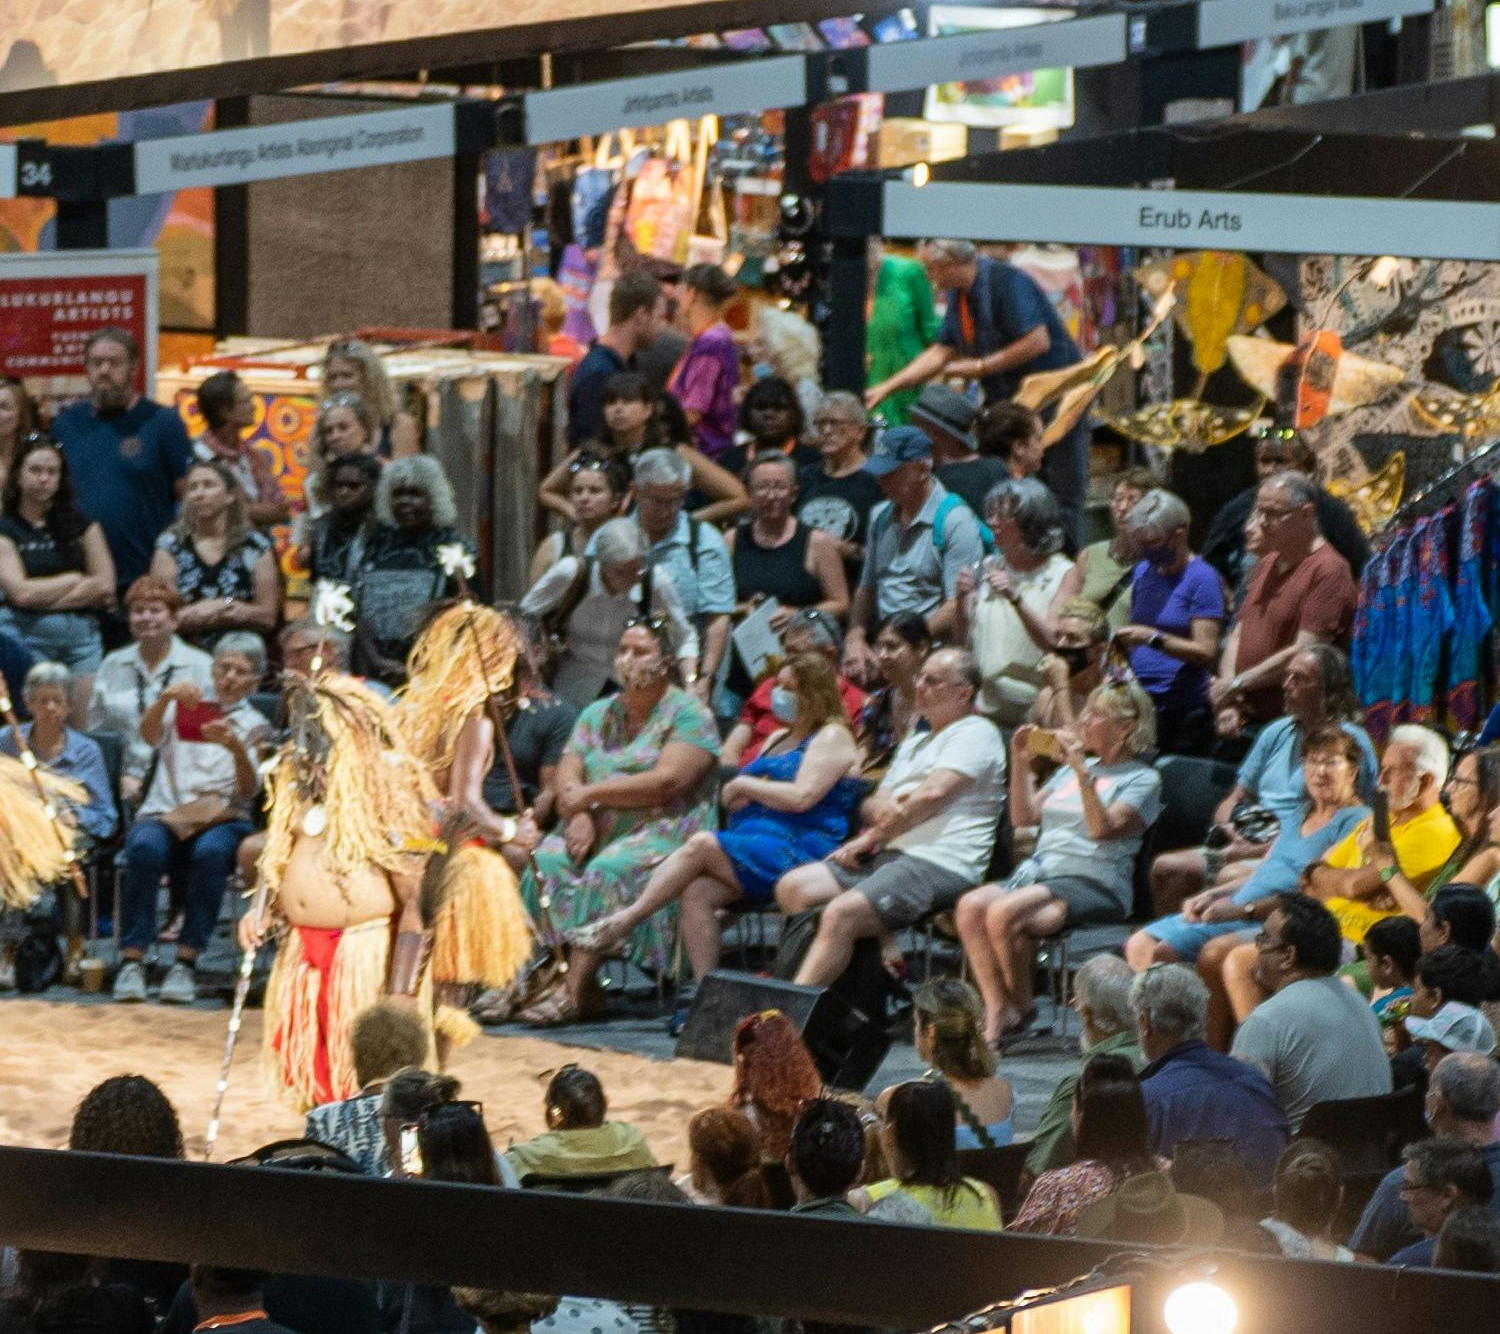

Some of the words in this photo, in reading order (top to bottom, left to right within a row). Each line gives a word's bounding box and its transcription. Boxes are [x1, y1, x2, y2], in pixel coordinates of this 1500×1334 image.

[21, 161, 52, 186] 34
[1139, 206, 1191, 230] Erub
[1198, 208, 1243, 232] Arts
